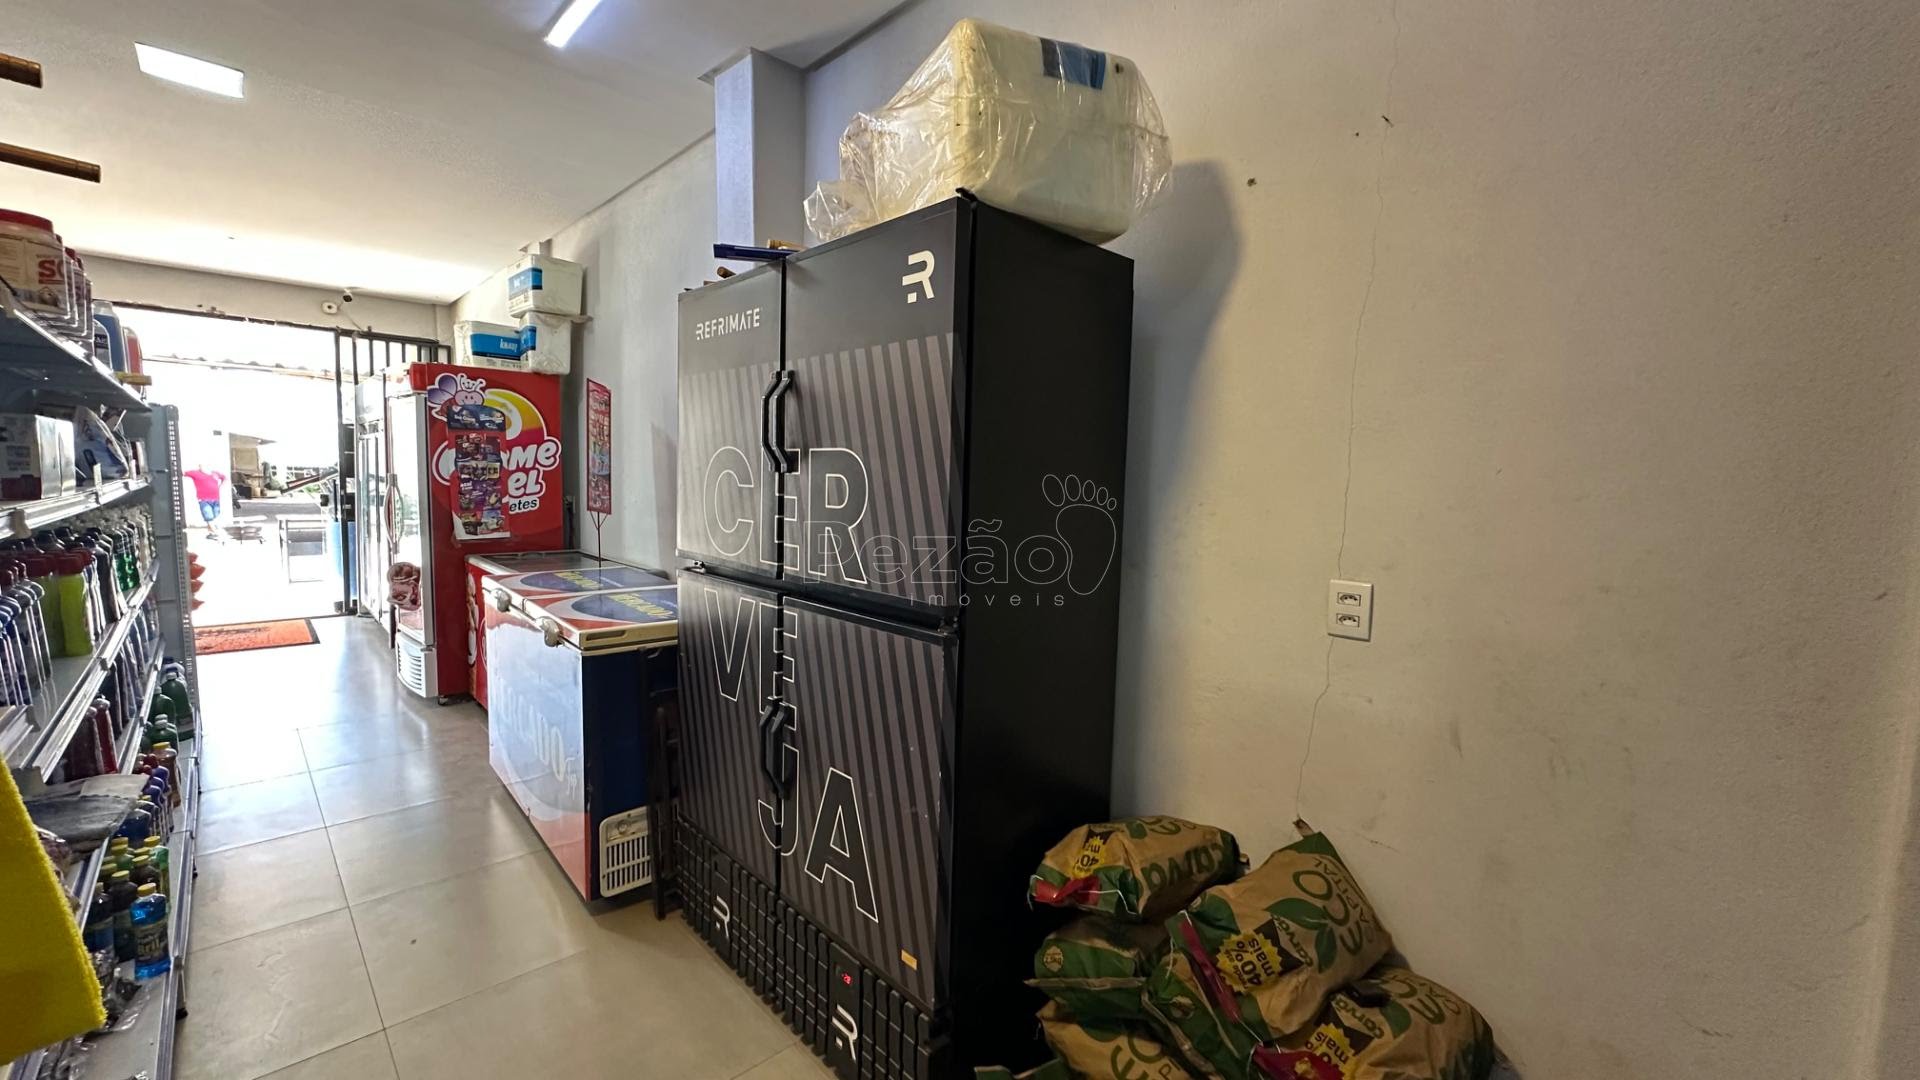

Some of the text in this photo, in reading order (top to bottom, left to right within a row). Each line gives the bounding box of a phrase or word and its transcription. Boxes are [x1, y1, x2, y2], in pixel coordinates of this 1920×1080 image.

[695, 307, 761, 341] REFRIMATE
[509, 498, 538, 512] etes
[703, 446, 869, 584] CER
[1293, 869, 1363, 955] ECO
[1229, 939, 1264, 987] 40%
[1248, 936, 1277, 978] mais
[1314, 1030, 1351, 1065] mais
